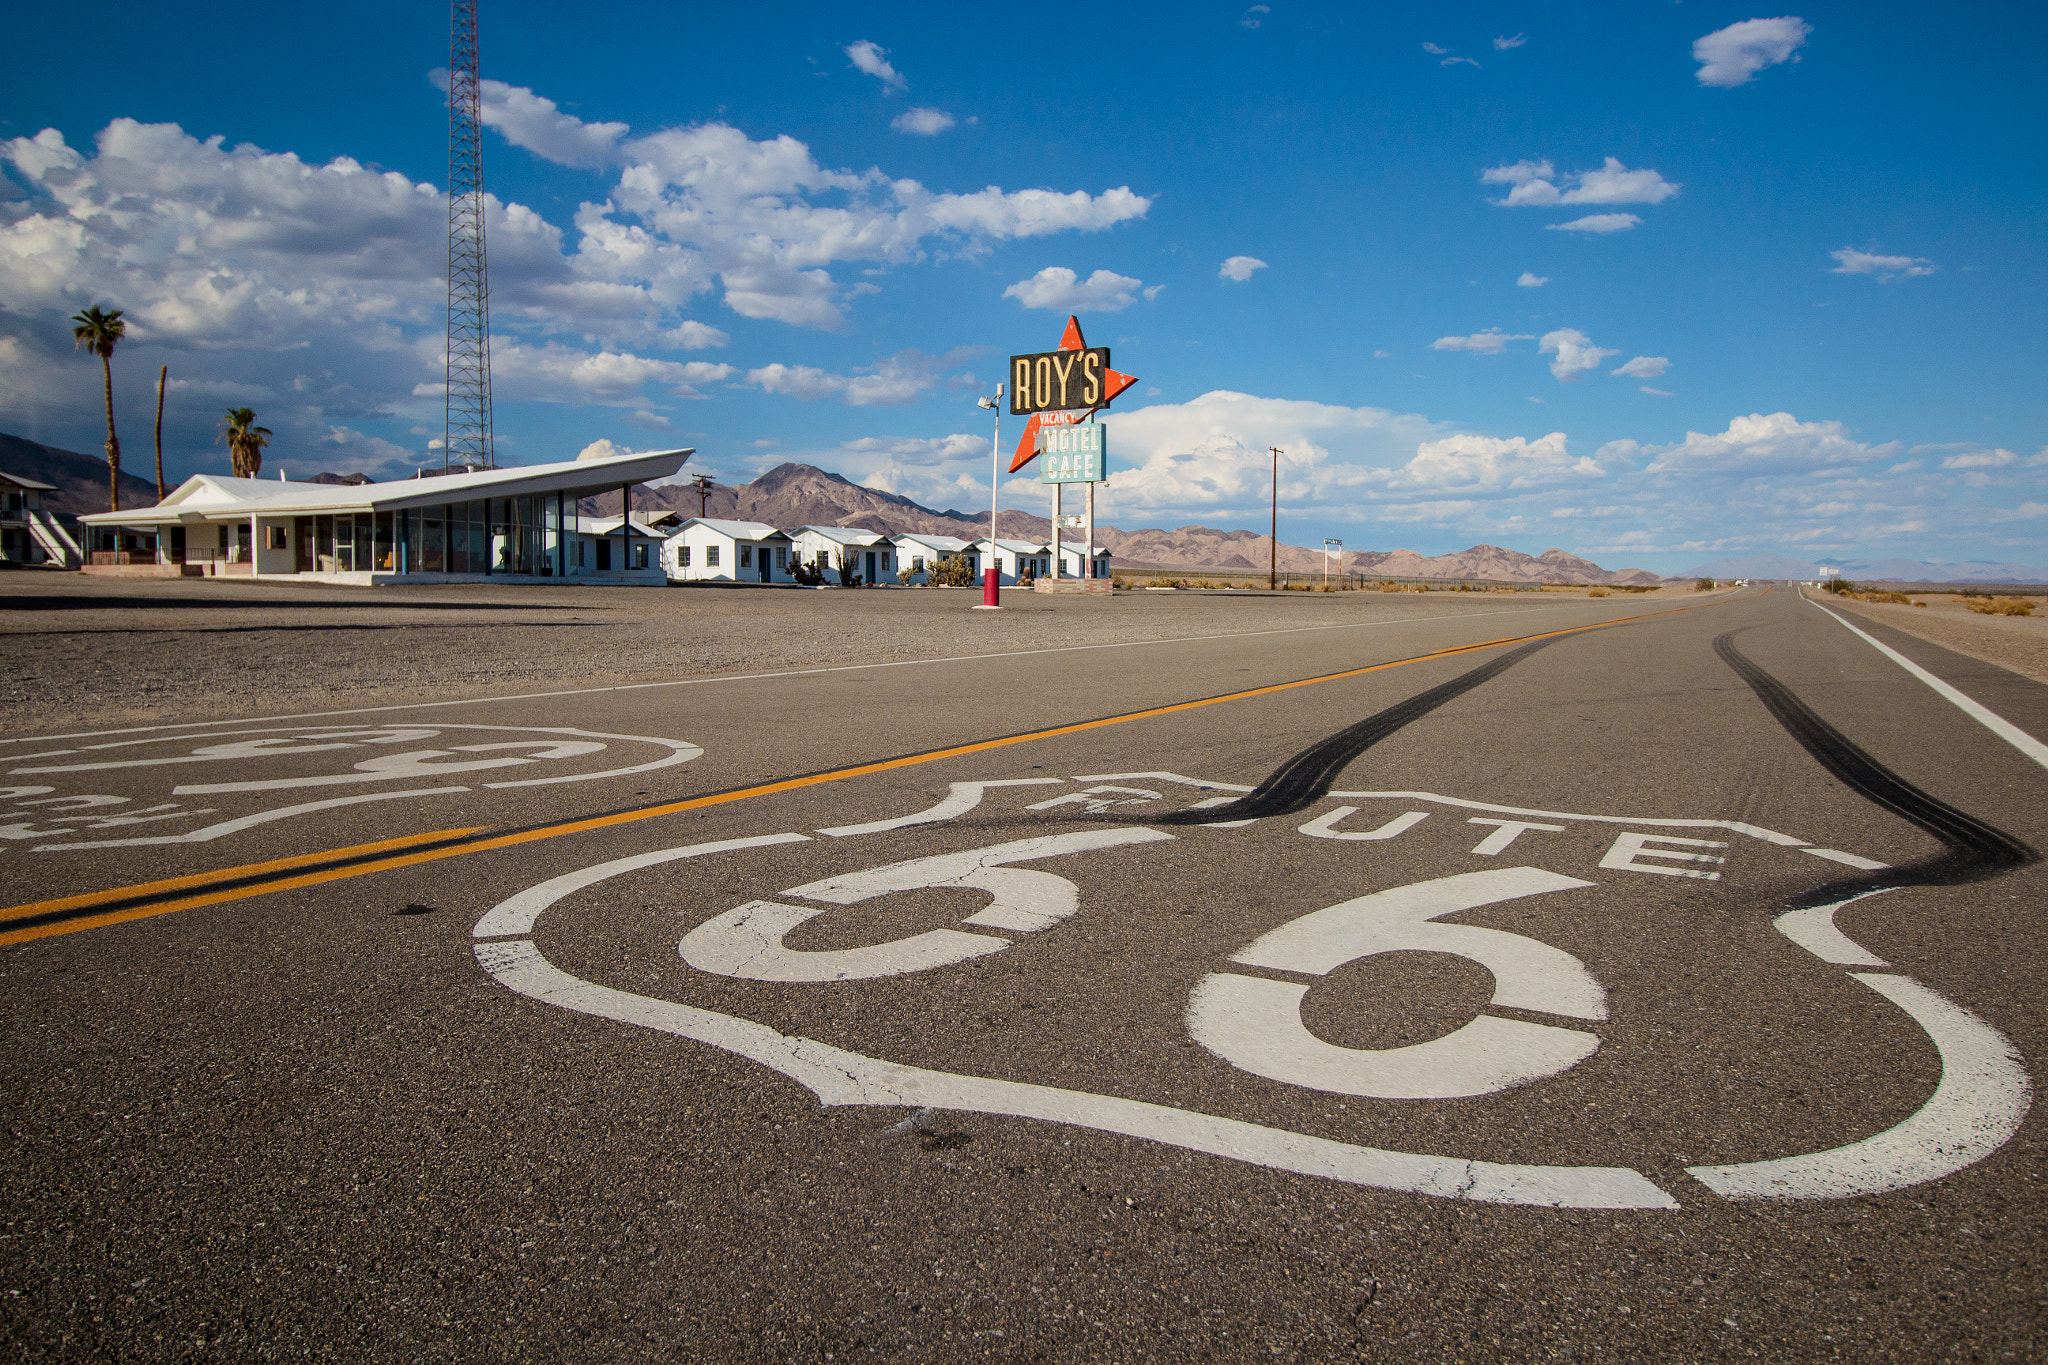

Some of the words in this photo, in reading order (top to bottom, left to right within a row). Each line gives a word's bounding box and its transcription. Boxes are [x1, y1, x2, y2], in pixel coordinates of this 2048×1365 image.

[1015, 351, 1099, 410] ROY'S
[1039, 411, 1076, 425] VACANCY
[1044, 427, 1099, 453] MOTEL
[1048, 454, 1093, 479] CAFE
[679, 827, 1609, 1100] 66
